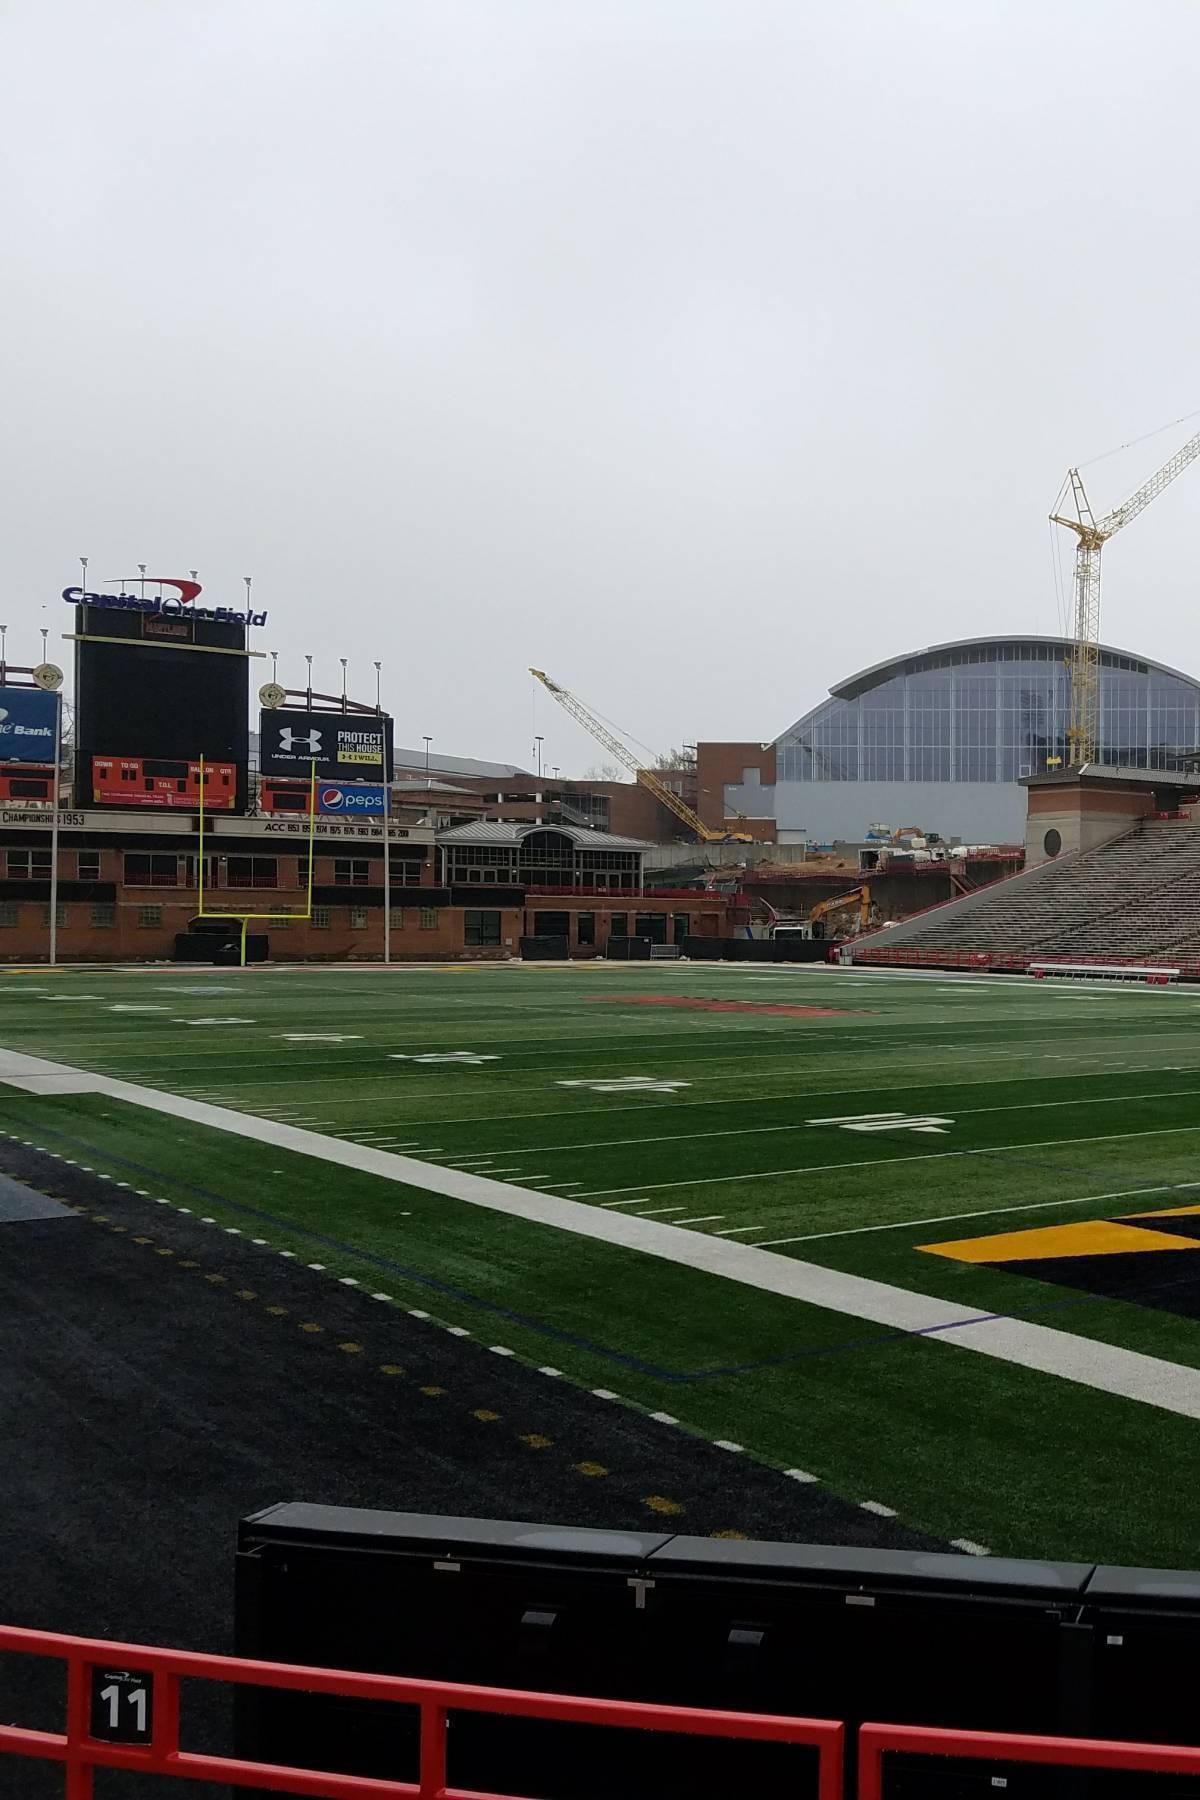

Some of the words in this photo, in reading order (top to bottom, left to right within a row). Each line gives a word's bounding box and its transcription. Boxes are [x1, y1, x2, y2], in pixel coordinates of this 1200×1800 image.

[14, 725, 52, 736] Bank
[337, 731, 382, 745] PROTECT
[337, 743, 355, 752] THIS
[356, 745, 382, 753] HOUSE
[63, 814, 85, 826] 1953
[264, 824, 286, 832] ACC
[804, 1112, 956, 1132] 10
[100, 1685, 146, 1731] 11
